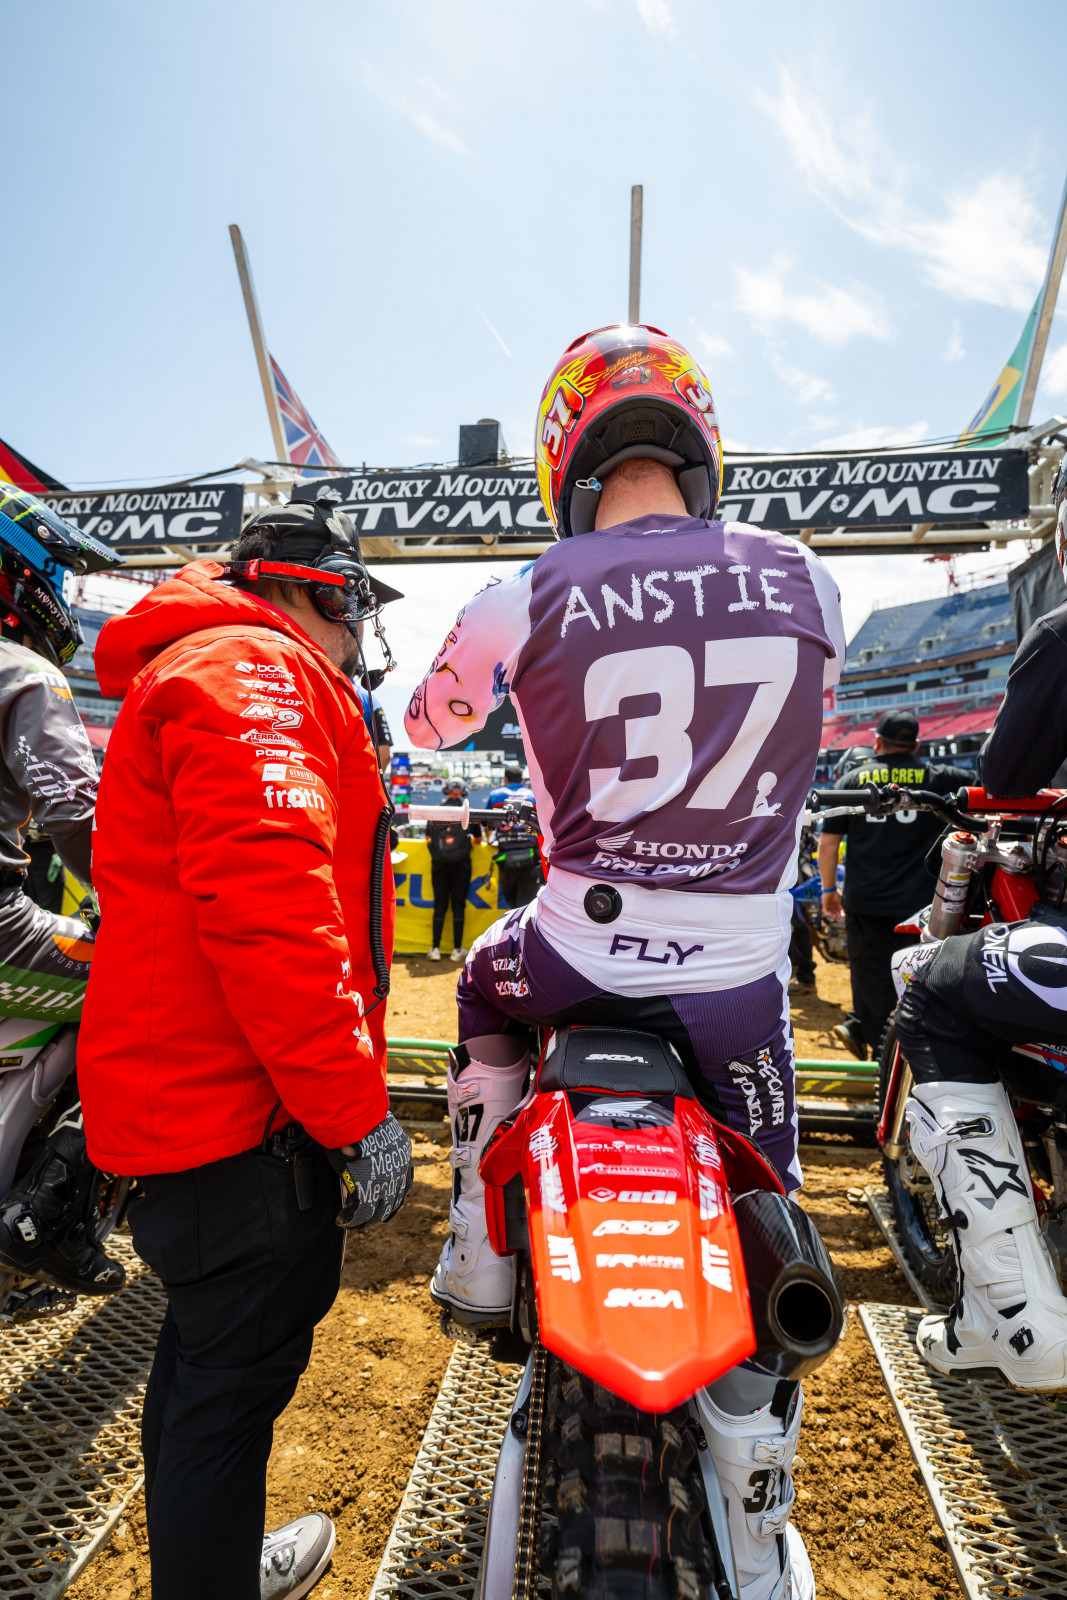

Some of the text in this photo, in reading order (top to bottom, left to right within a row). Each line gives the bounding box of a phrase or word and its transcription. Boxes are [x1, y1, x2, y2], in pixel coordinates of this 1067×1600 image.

[542, 385, 573, 457] 37
[727, 457, 1003, 491] ROCKY MOUNTAIN
[346, 478, 432, 501] ROCKY
[101, 490, 226, 513] MOUNTAIN
[560, 564, 795, 638] ANSTIE
[248, 693, 304, 707] DUNLOP
[583, 636, 799, 823] 37
[858, 768, 925, 785] FLAG CREW
[632, 840, 748, 859] HONDA
[609, 933, 704, 966] FLY
[457, 1103, 484, 1143] 37
[589, 1111, 658, 1121] HONDA
[576, 1140, 676, 1154] POLYFLOR
